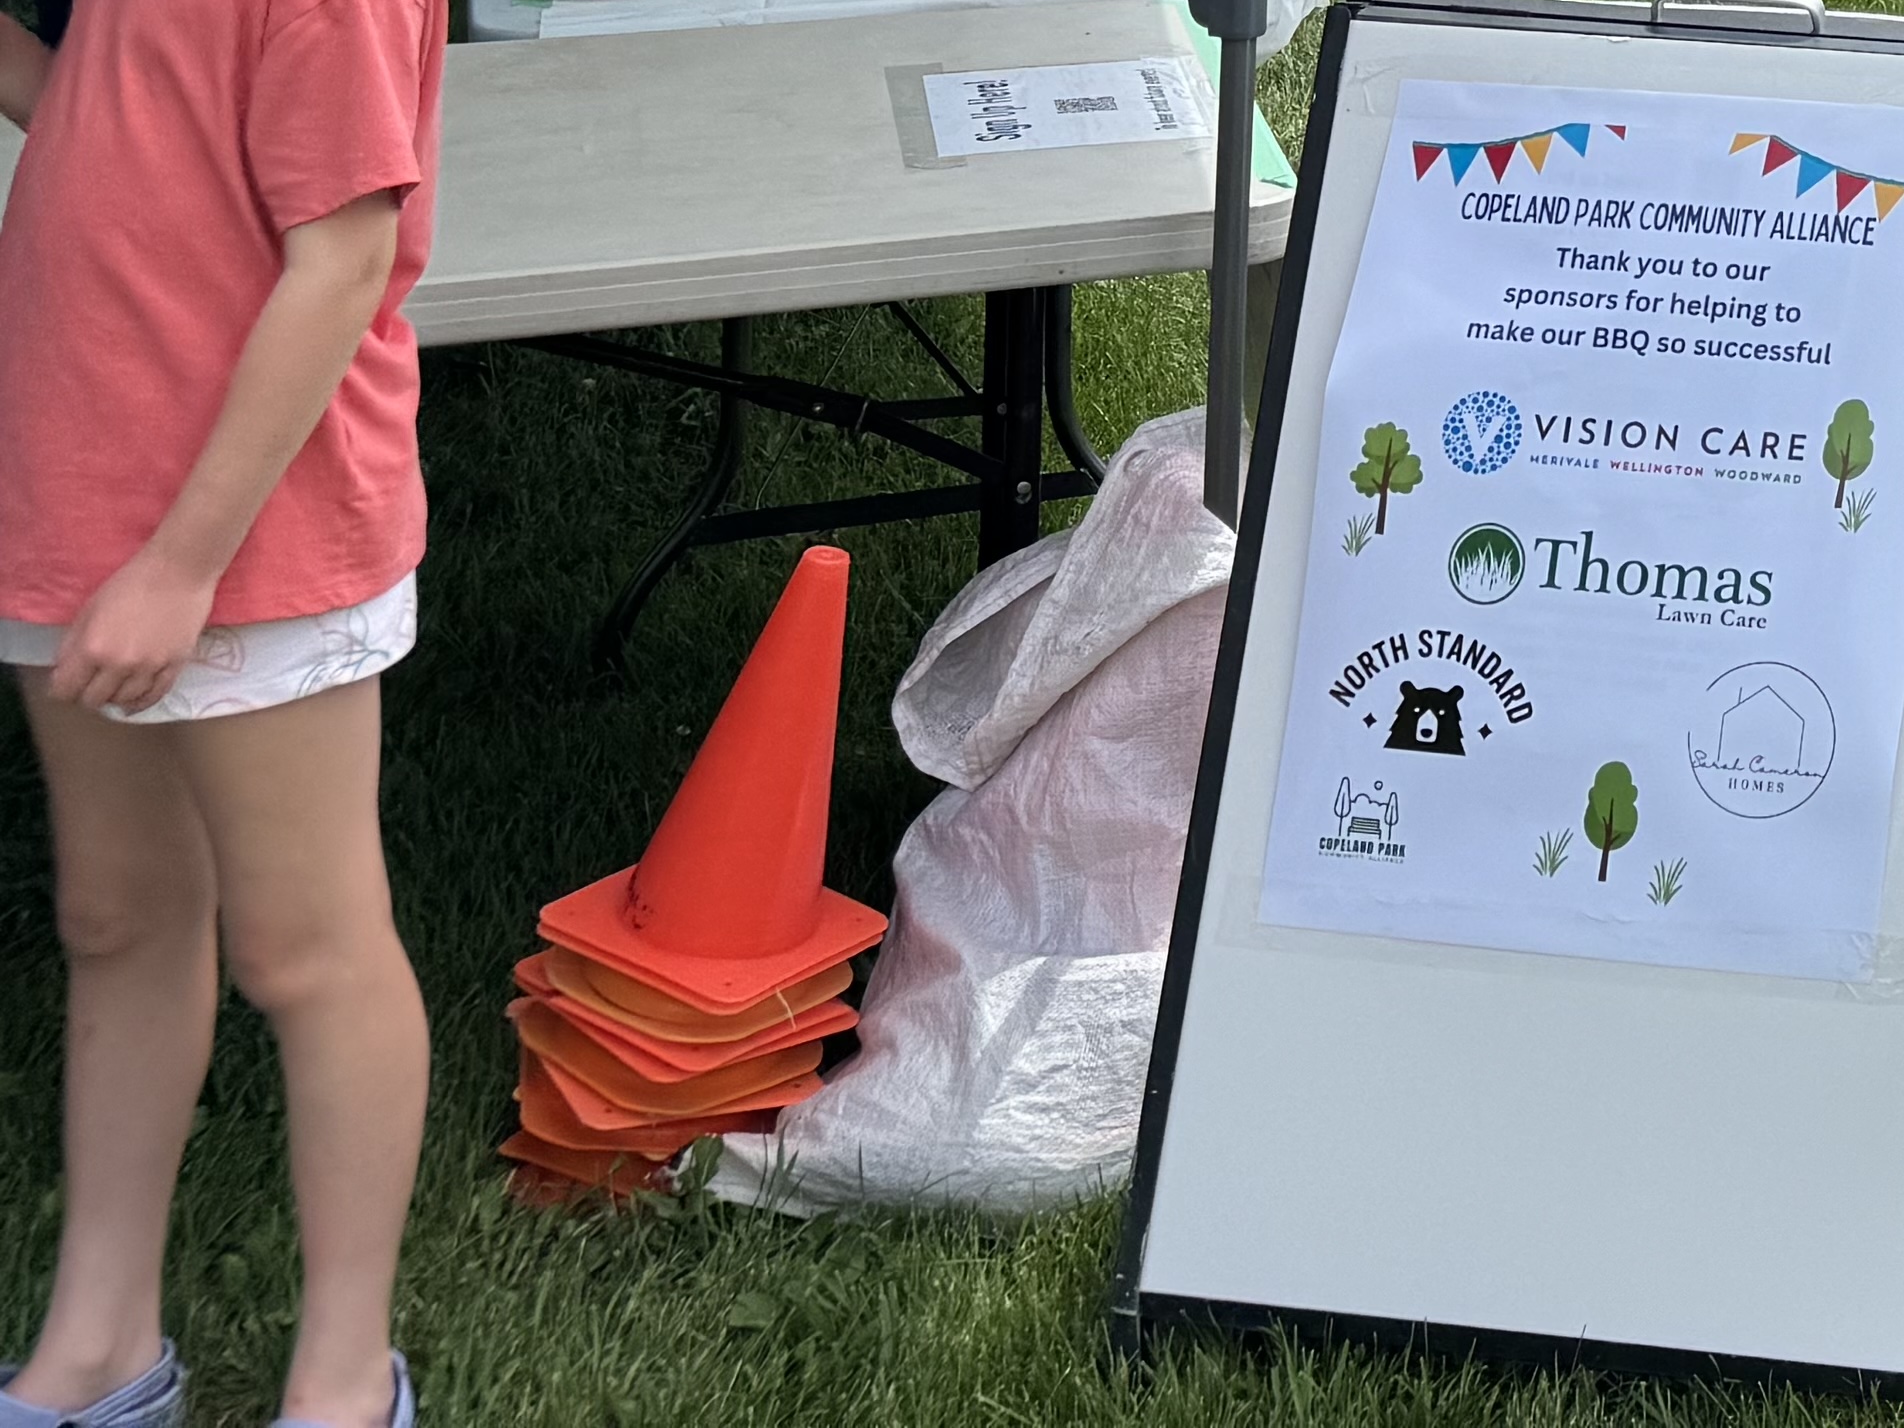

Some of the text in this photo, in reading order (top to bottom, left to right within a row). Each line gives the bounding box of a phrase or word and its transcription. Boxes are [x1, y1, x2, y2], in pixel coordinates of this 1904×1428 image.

[962, 80, 1032, 142] Sign Up Here!
[1461, 192, 1877, 246] COPELAND PARK COMMUNITY ALLIANCE
[1556, 247, 1771, 282] Thank you to our
[1503, 286, 1801, 326] sponsors for helping to
[1466, 319, 1832, 365] make our BBQ so successful
[1535, 414, 1807, 461] VISION CARE
[1529, 455, 1802, 484] MERIVALE WELLINGTON WOODWARD
[1534, 530, 1774, 607] Thomas
[1655, 603, 1768, 630] Lawn Care
[1328, 629, 1535, 725] NORTH STANDARD
[1728, 777, 1785, 794] HOMES
[1319, 837, 1374, 855] COPELAND
[1378, 843, 1406, 858] PARK
